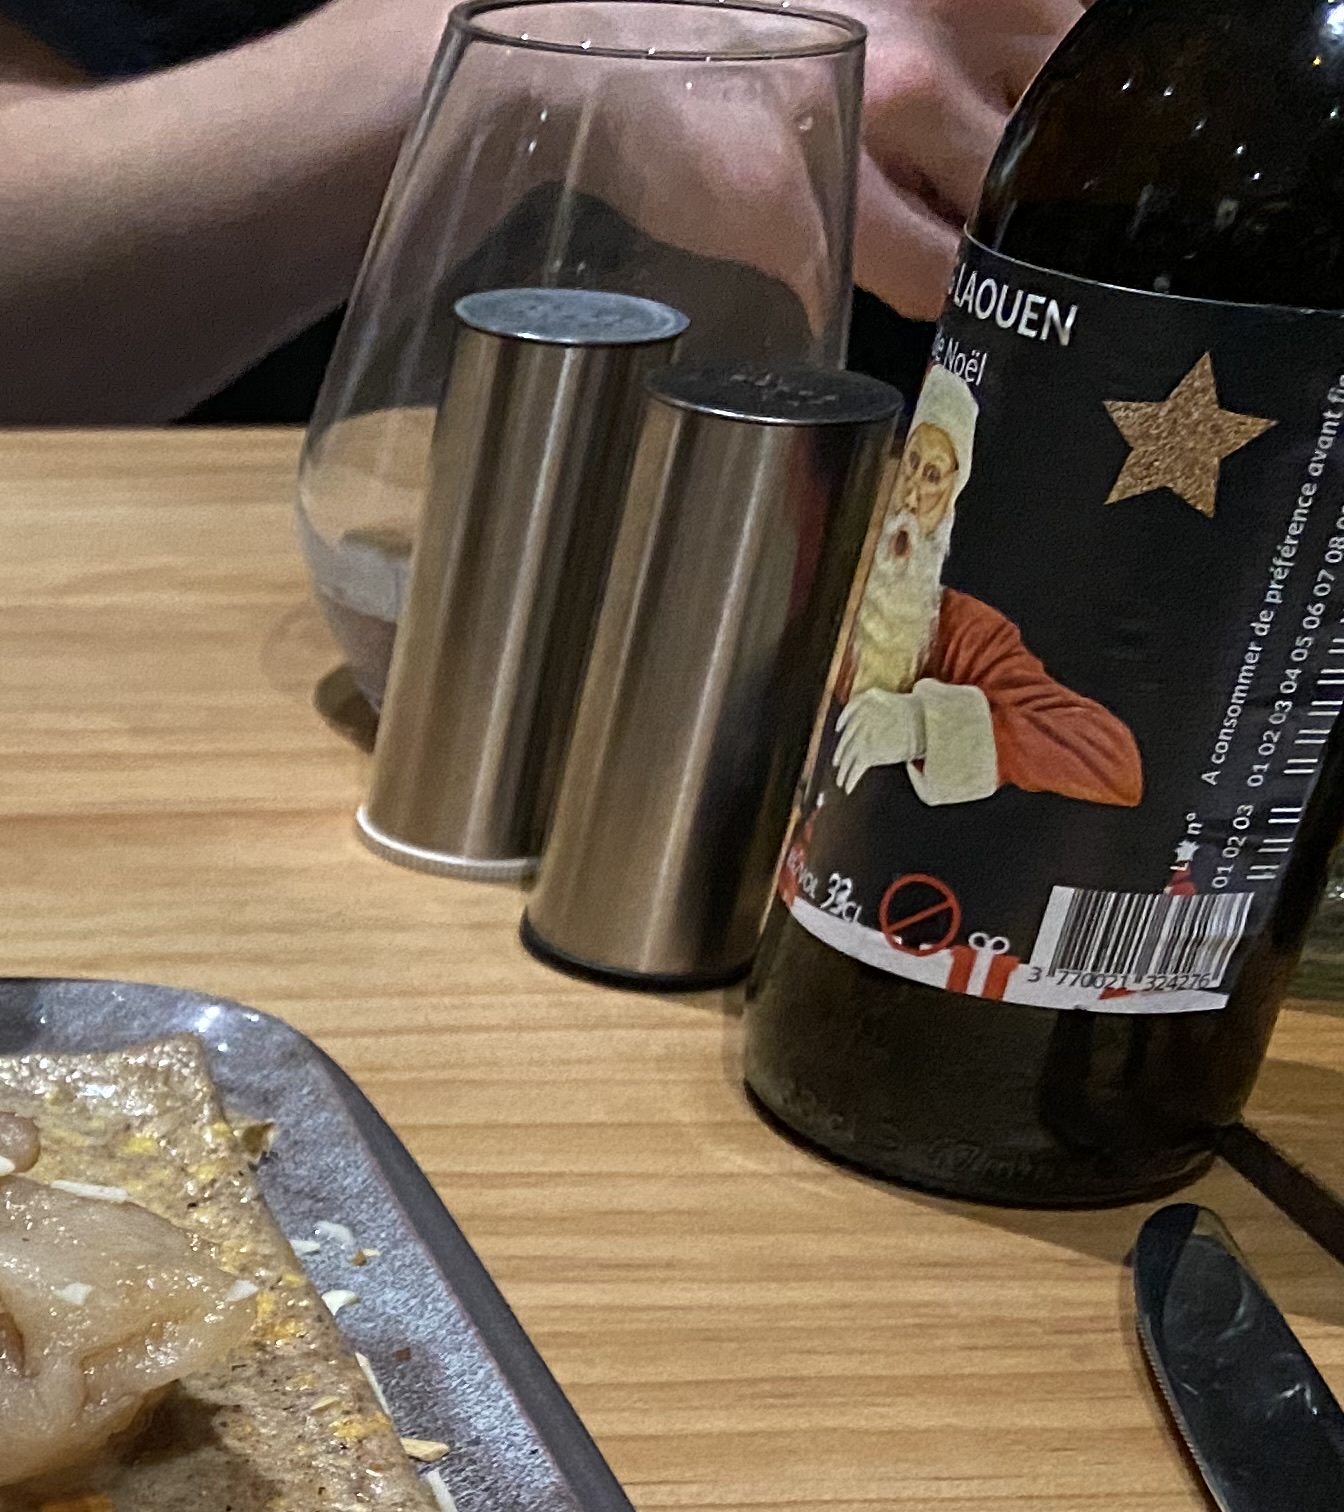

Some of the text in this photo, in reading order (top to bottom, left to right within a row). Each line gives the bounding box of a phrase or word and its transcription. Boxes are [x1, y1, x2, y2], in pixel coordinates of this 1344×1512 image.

[953, 262, 1079, 347] LAOUEN
[943, 337, 988, 387] Noël
[1201, 770, 1221, 786] A
[1211, 641, 1263, 764] consommer
[1249, 609, 1275, 637] de
[1264, 482, 1317, 604] préférence
[1308, 410, 1343, 477] avant
[1247, 536, 1344, 788] 01 02 03 04 05 06 07 08
[1212, 804, 1254, 889] 01 02 03
[1027, 966, 1043, 983] 3
[1145, 972, 1211, 991] 324276
